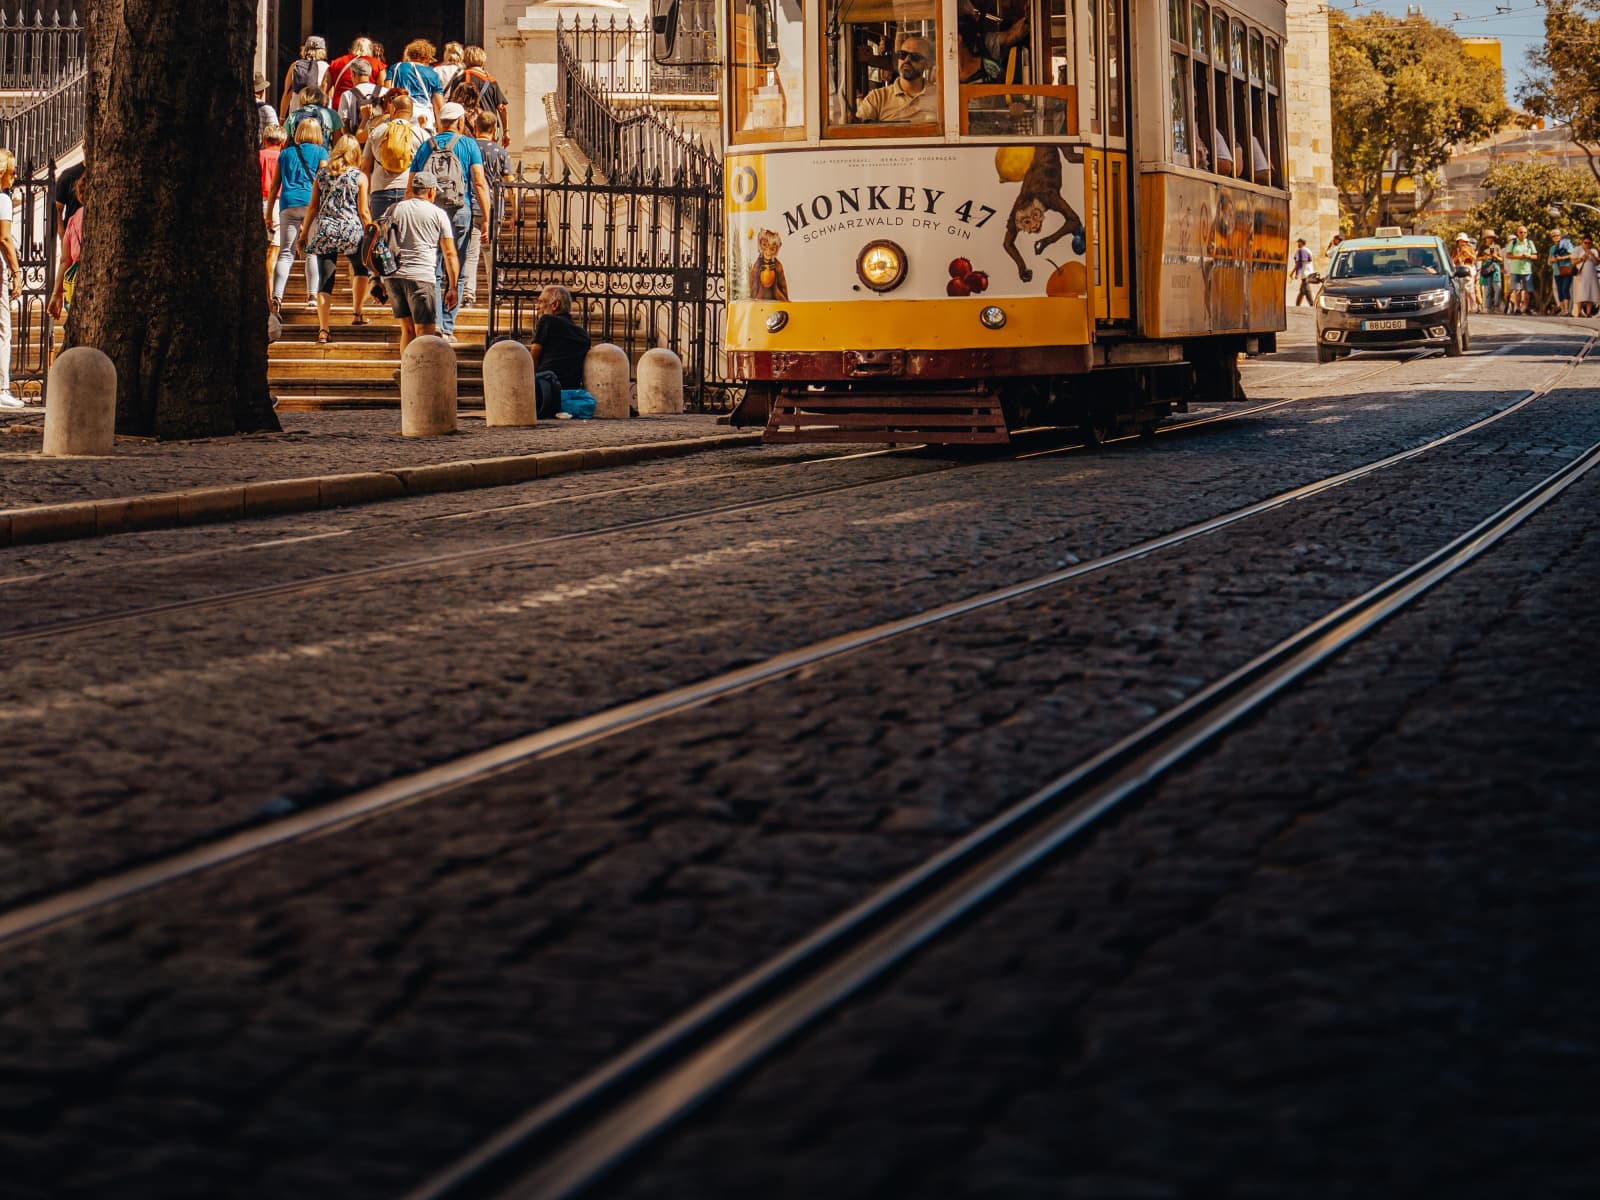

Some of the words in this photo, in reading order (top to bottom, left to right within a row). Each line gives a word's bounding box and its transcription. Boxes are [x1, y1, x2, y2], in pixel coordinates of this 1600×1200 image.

[783, 185, 946, 236] MONKEY
[955, 200, 997, 228] 47
[803, 216, 904, 243] SCHWARZWALD
[912, 218, 941, 231] DRY
[947, 225, 972, 240] GIN
